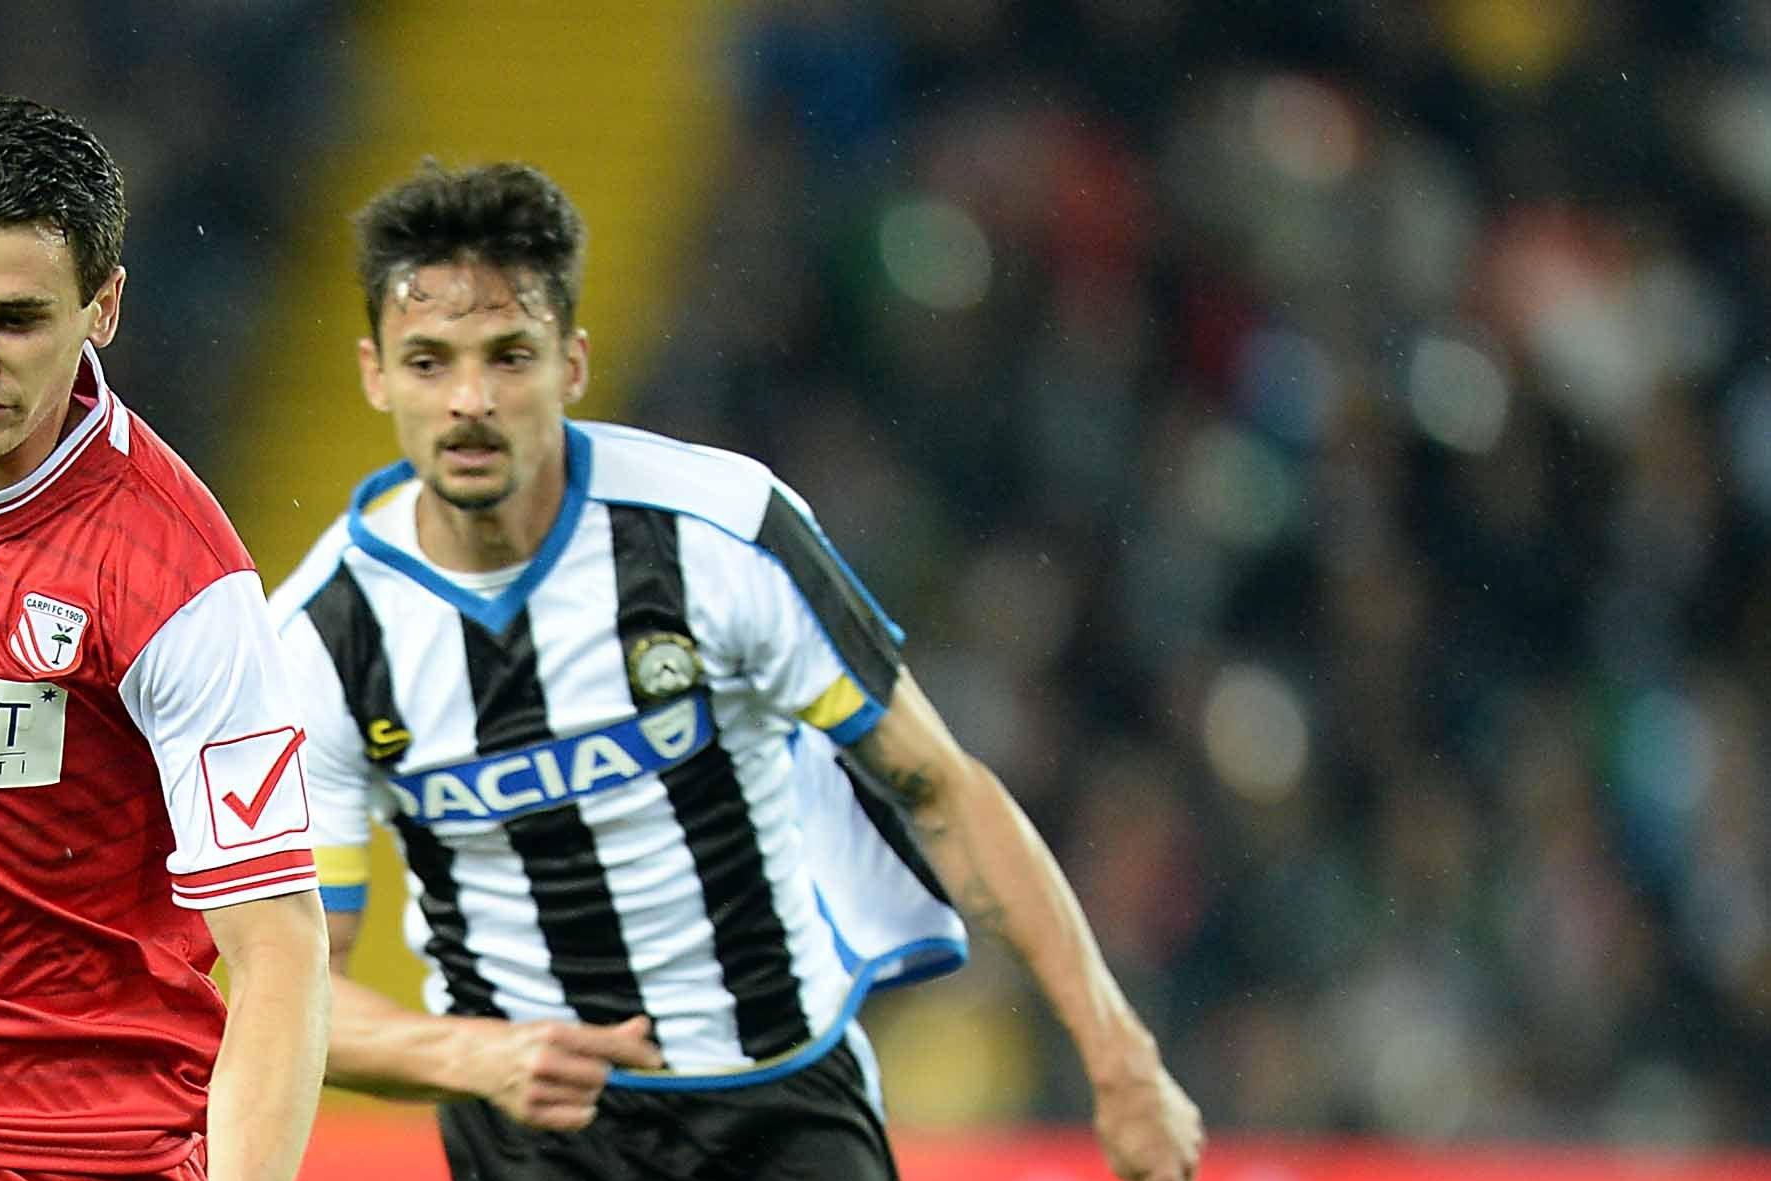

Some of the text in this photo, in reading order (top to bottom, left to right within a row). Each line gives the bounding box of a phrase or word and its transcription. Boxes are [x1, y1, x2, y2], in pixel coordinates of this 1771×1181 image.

[26, 598, 85, 624] CARPI FC 1909
